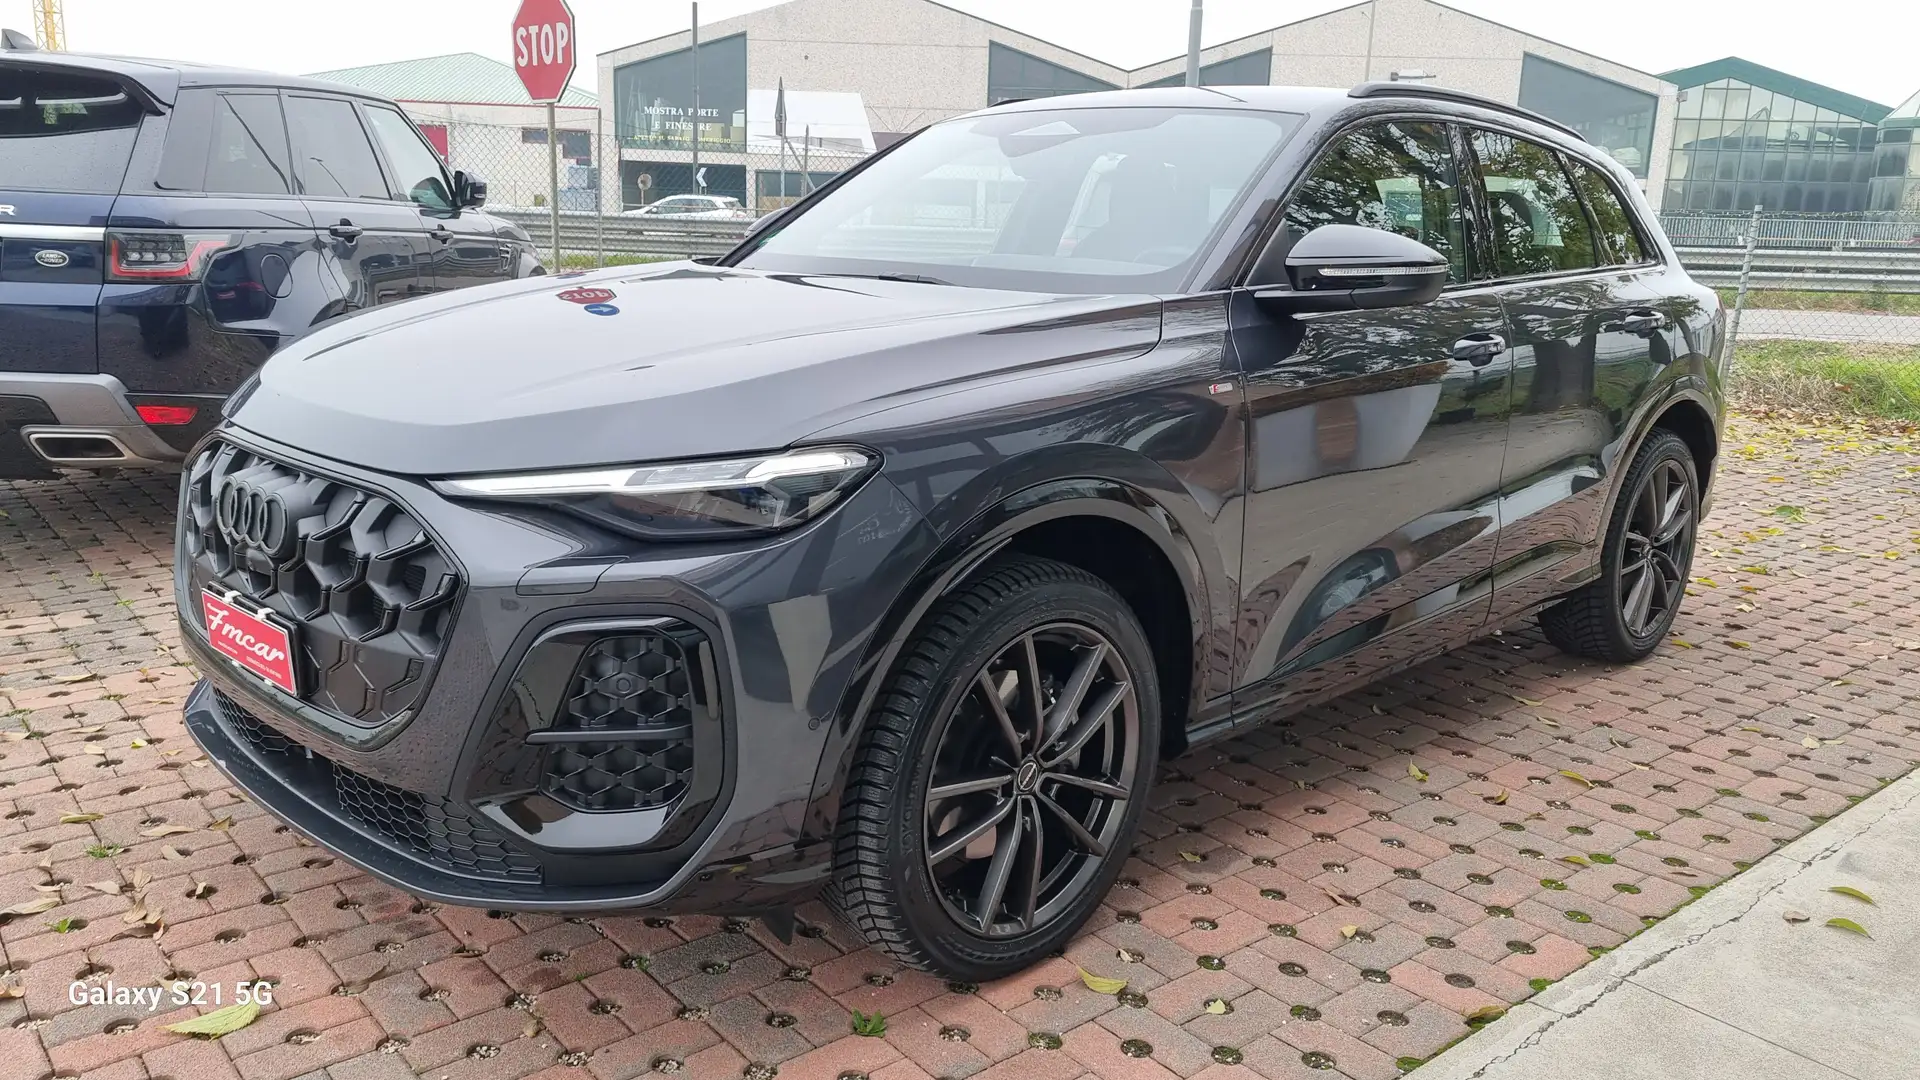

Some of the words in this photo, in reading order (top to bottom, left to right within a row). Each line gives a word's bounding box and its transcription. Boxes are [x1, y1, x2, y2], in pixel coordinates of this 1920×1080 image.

[516, 22, 569, 67] STOP
[644, 106, 684, 116] MOSTRA
[655, 121, 661, 130] E
[665, 121, 712, 131] FINESRE
